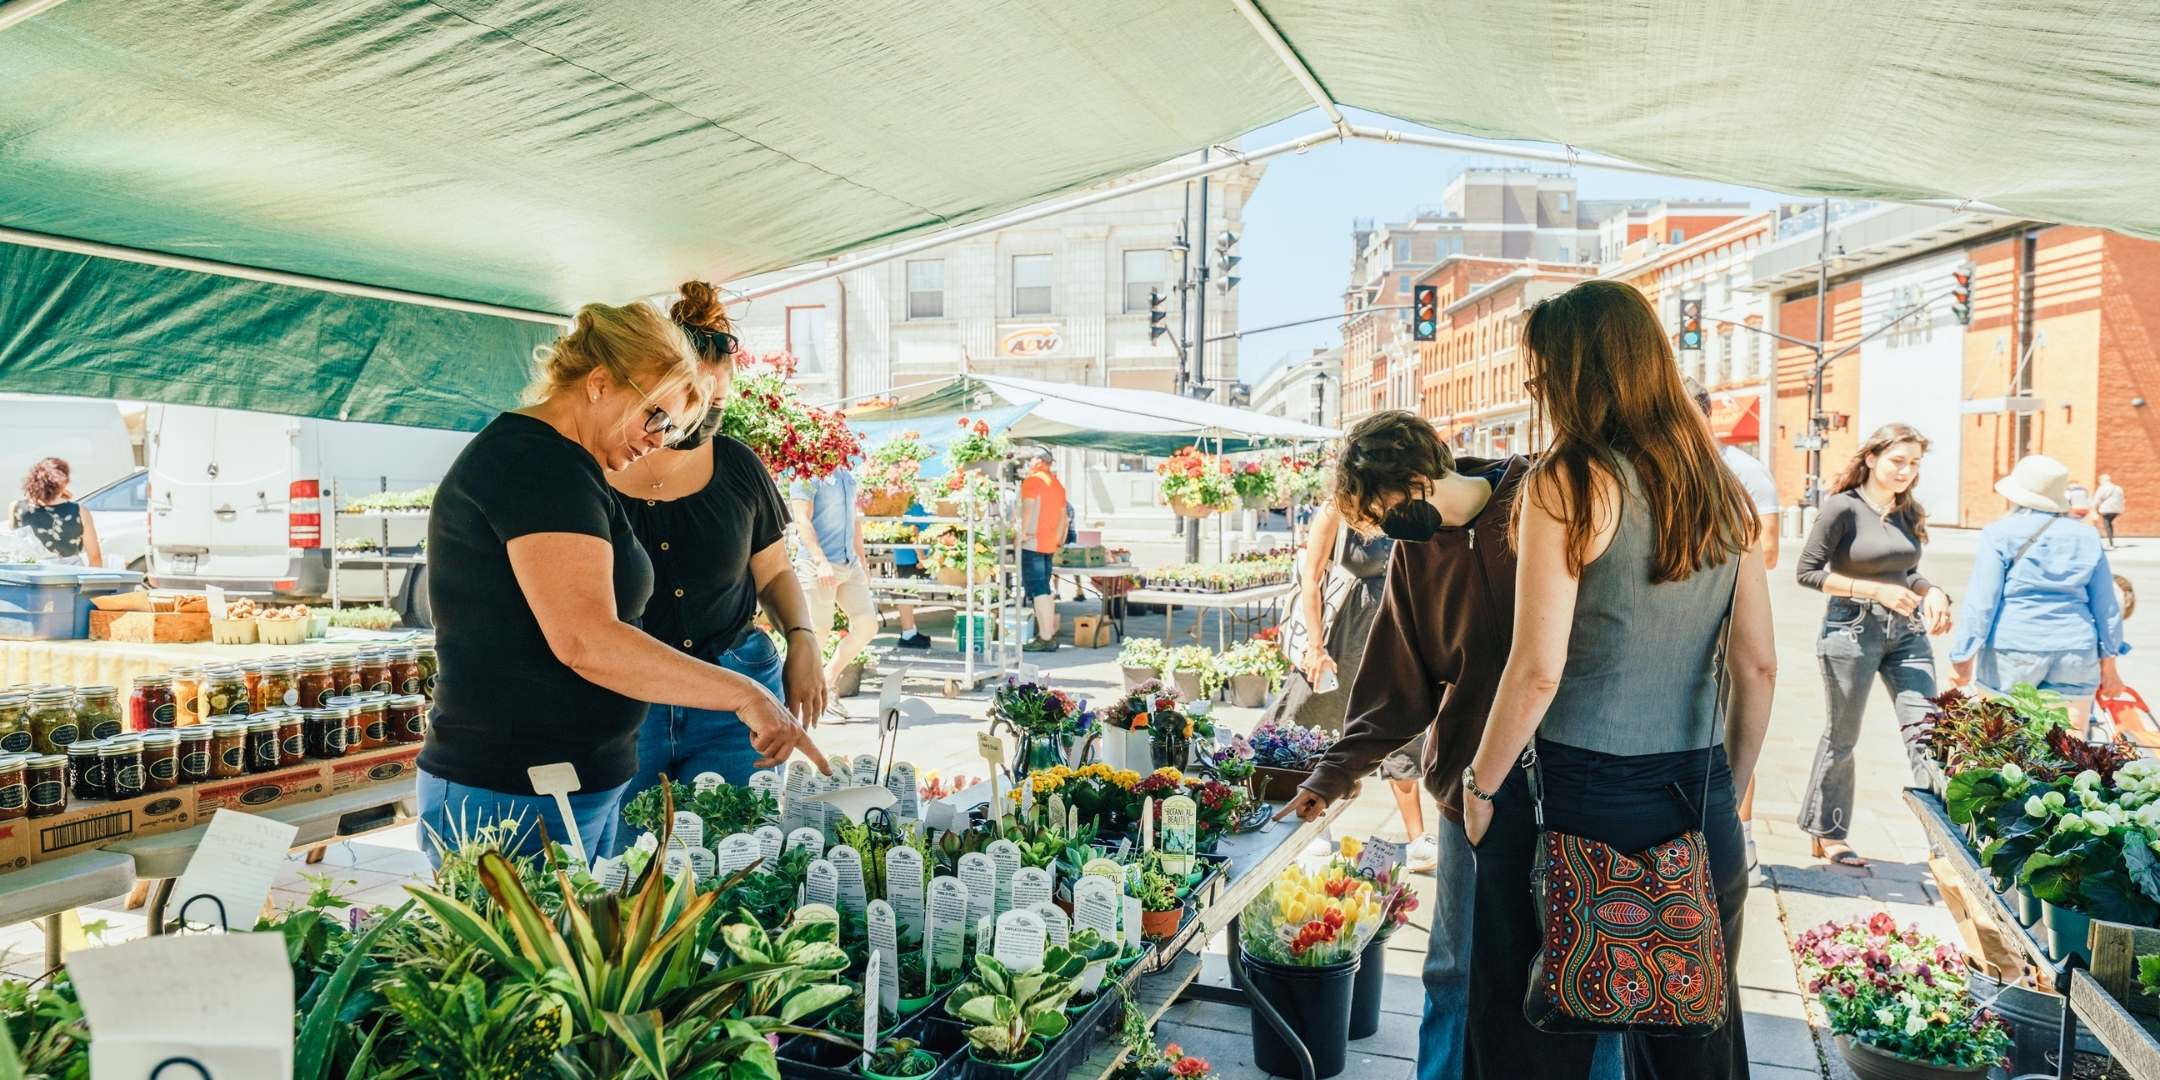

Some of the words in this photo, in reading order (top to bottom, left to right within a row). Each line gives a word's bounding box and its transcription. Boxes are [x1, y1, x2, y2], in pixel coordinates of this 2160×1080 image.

[1010, 338, 1058, 353] A&W
[1165, 807, 1193, 816] BOTANAL
[1168, 816, 1190, 824] BEAUTIS
